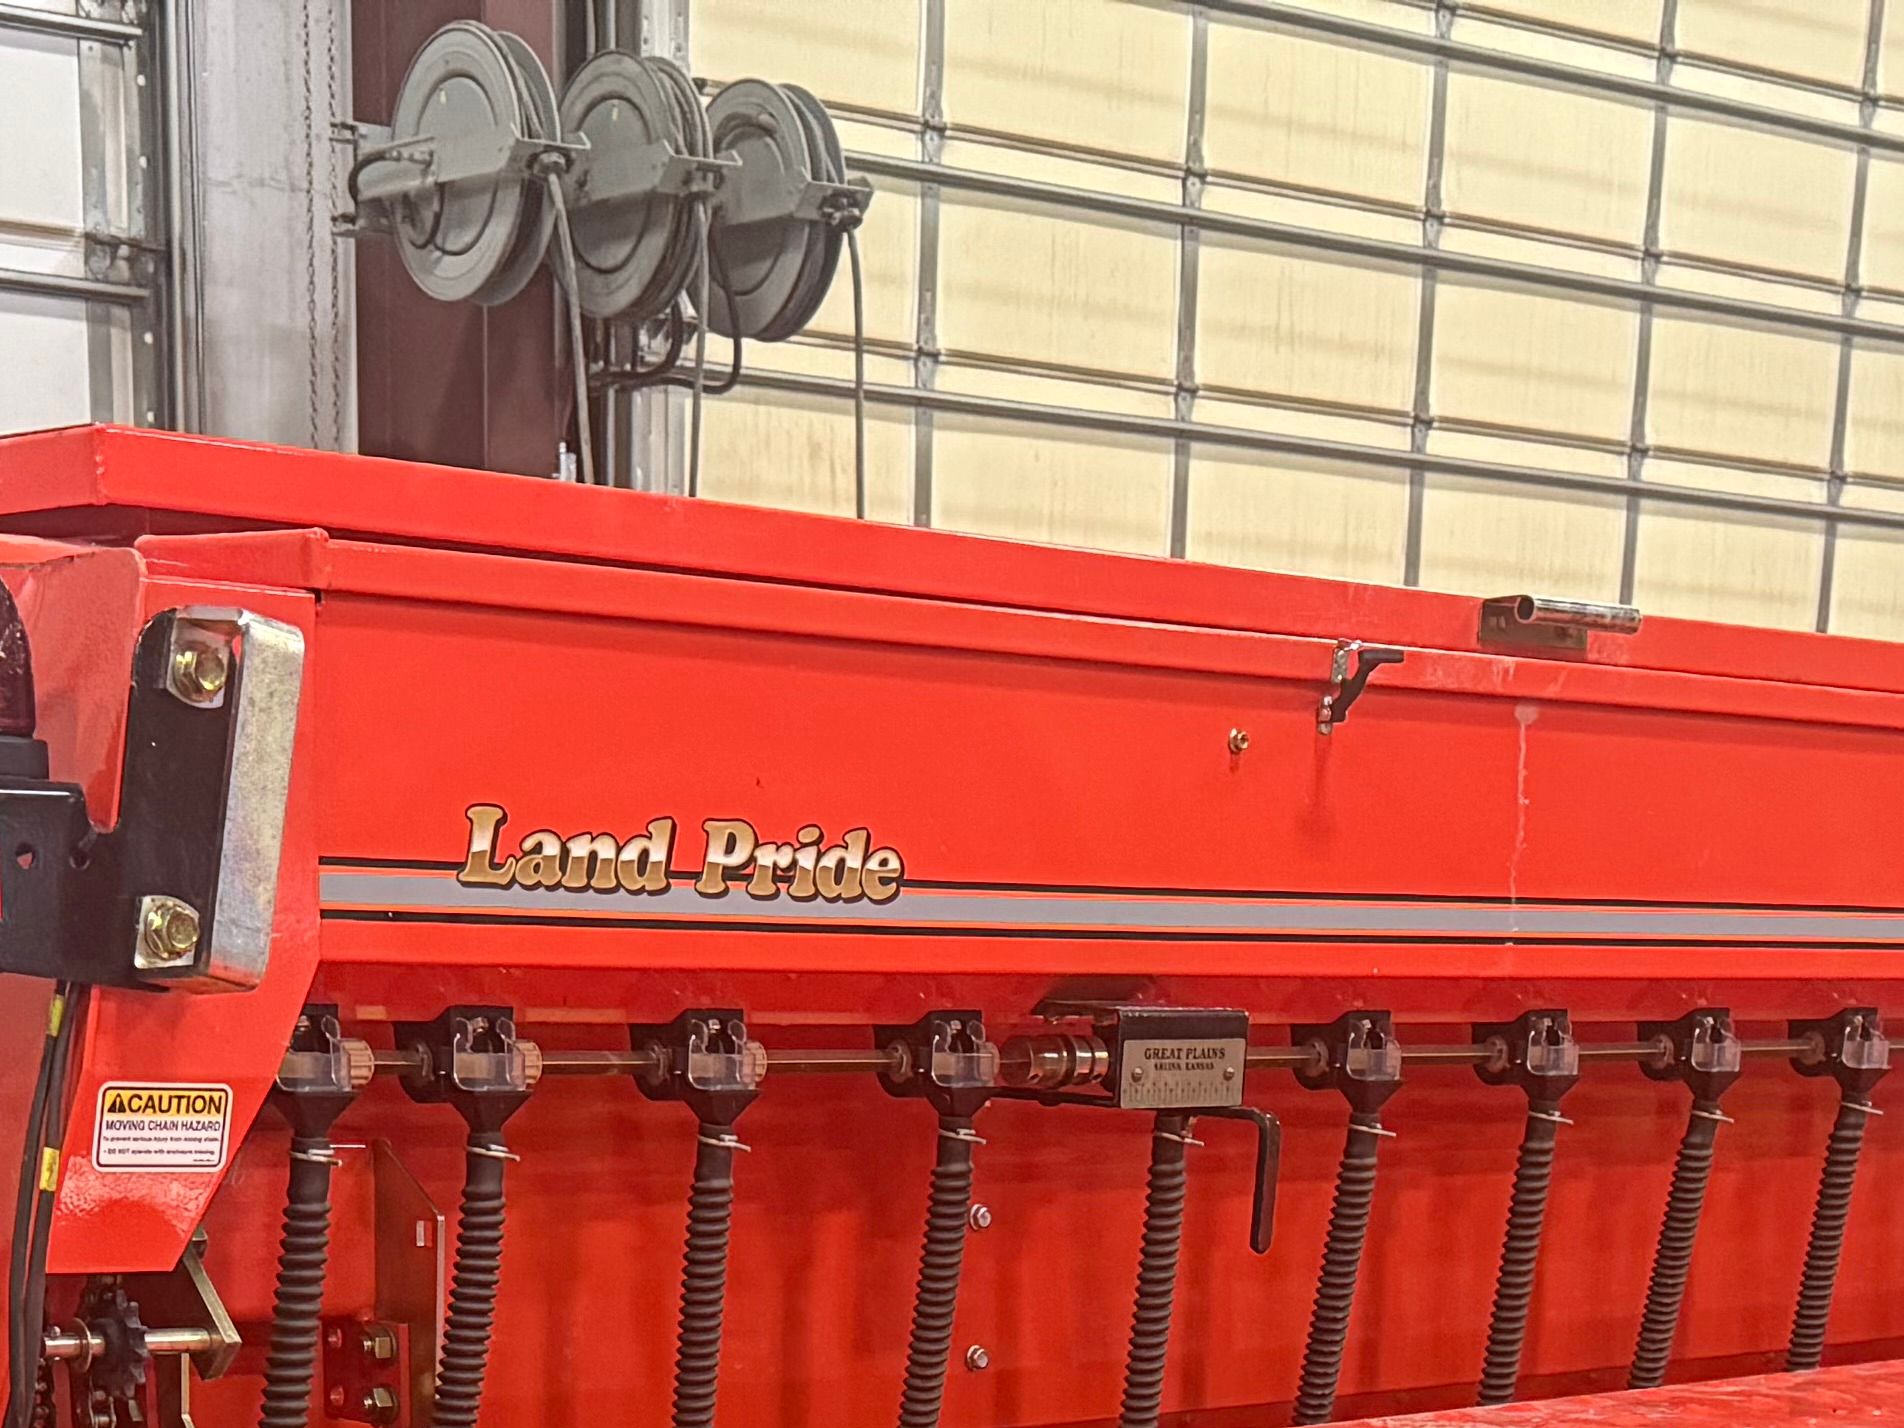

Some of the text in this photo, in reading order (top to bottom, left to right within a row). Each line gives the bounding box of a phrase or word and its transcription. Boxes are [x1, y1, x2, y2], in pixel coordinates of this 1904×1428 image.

[458, 803, 905, 902] Land Pride
[1144, 1047, 1226, 1060] GREAT PLAINS
[128, 1094, 222, 1114] CAUTION
[106, 1120, 220, 1131] MOVING CHAIN HAZARD
